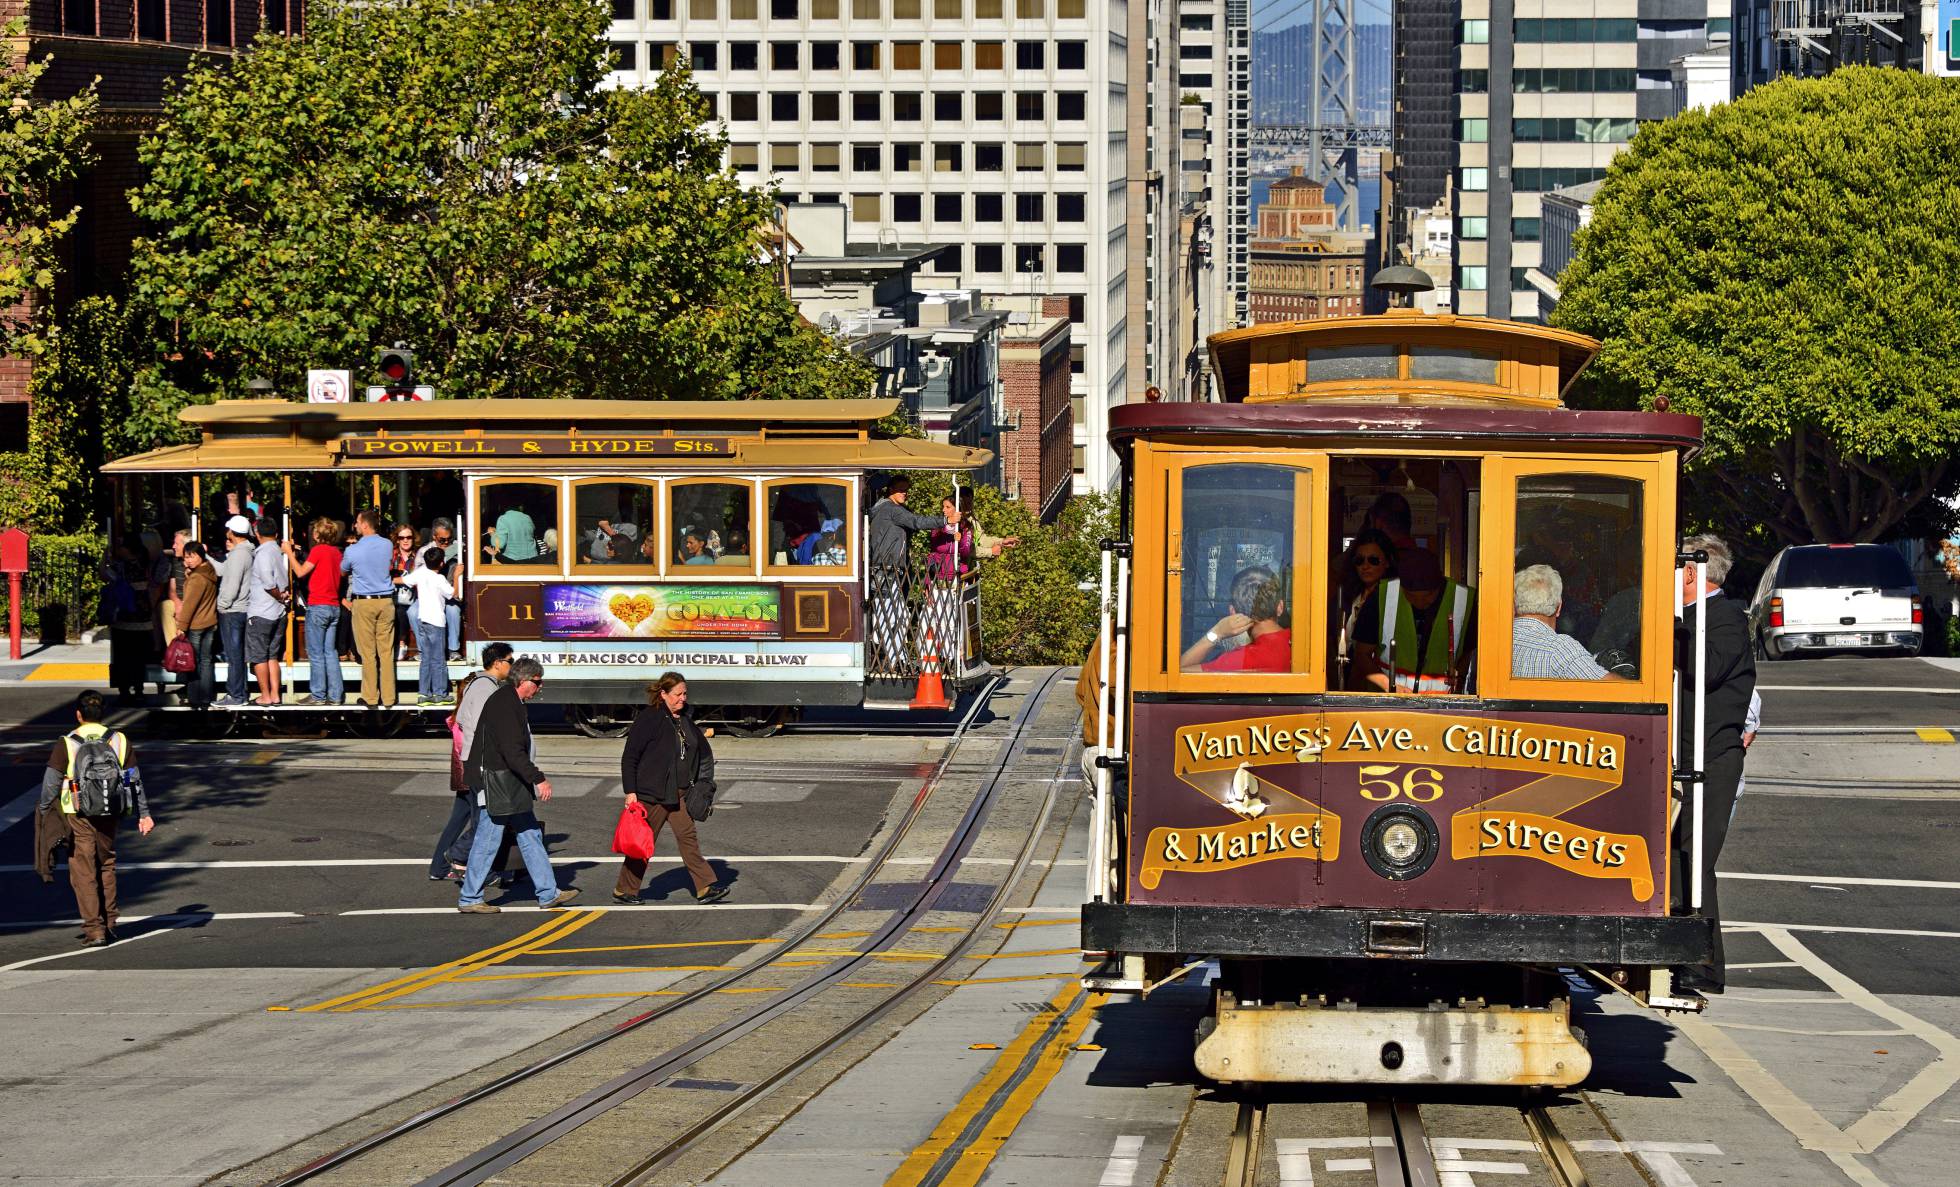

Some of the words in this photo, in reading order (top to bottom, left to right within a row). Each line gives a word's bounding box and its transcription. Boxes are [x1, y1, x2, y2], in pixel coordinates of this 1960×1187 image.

[364, 441, 496, 454] POWELL
[522, 441, 543, 454] &
[570, 440, 655, 453] HYDE
[673, 440, 720, 453] Sts.
[508, 604, 537, 620] 11
[558, 653, 649, 665] FRANCISCO
[655, 653, 739, 665] MUNICIPAL
[745, 654, 808, 666] RAILWAY
[1183, 731, 1243, 761] Van
[1248, 723, 1333, 753] Ness
[1440, 723, 1619, 770] California
[1358, 765, 1445, 803] 56
[1162, 838, 1189, 863] &
[1195, 818, 1326, 865] Market
[1479, 818, 1629, 869] Streets
